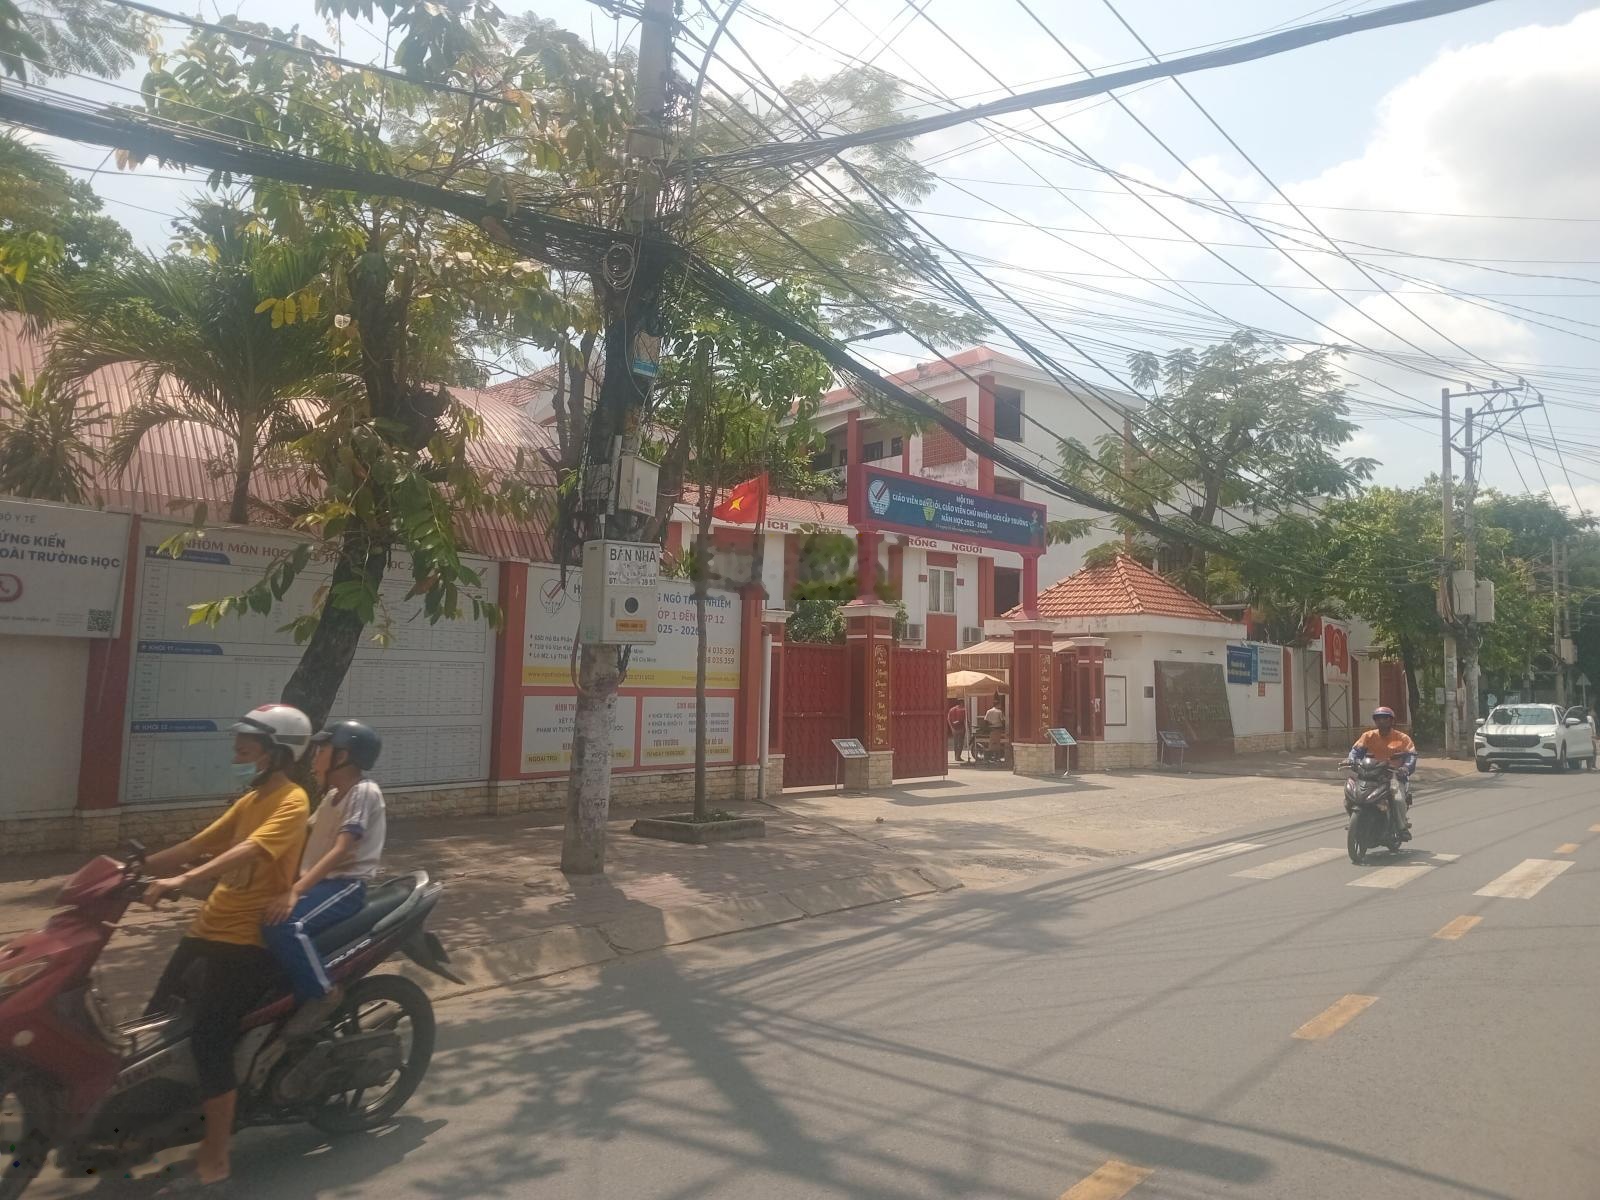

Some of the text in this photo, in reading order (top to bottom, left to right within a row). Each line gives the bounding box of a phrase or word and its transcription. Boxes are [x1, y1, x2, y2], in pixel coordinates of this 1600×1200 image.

[33, 533, 66, 548] KIẾN
[28, 549, 88, 566] TRƯỜNG
[90, 556, 121, 569] HỌC
[663, 591, 682, 604] NGÔ
[657, 607, 670, 620] ỚP
[672, 611, 677, 620] 1
[716, 615, 725, 624] 12
[657, 623, 673, 634] 025
